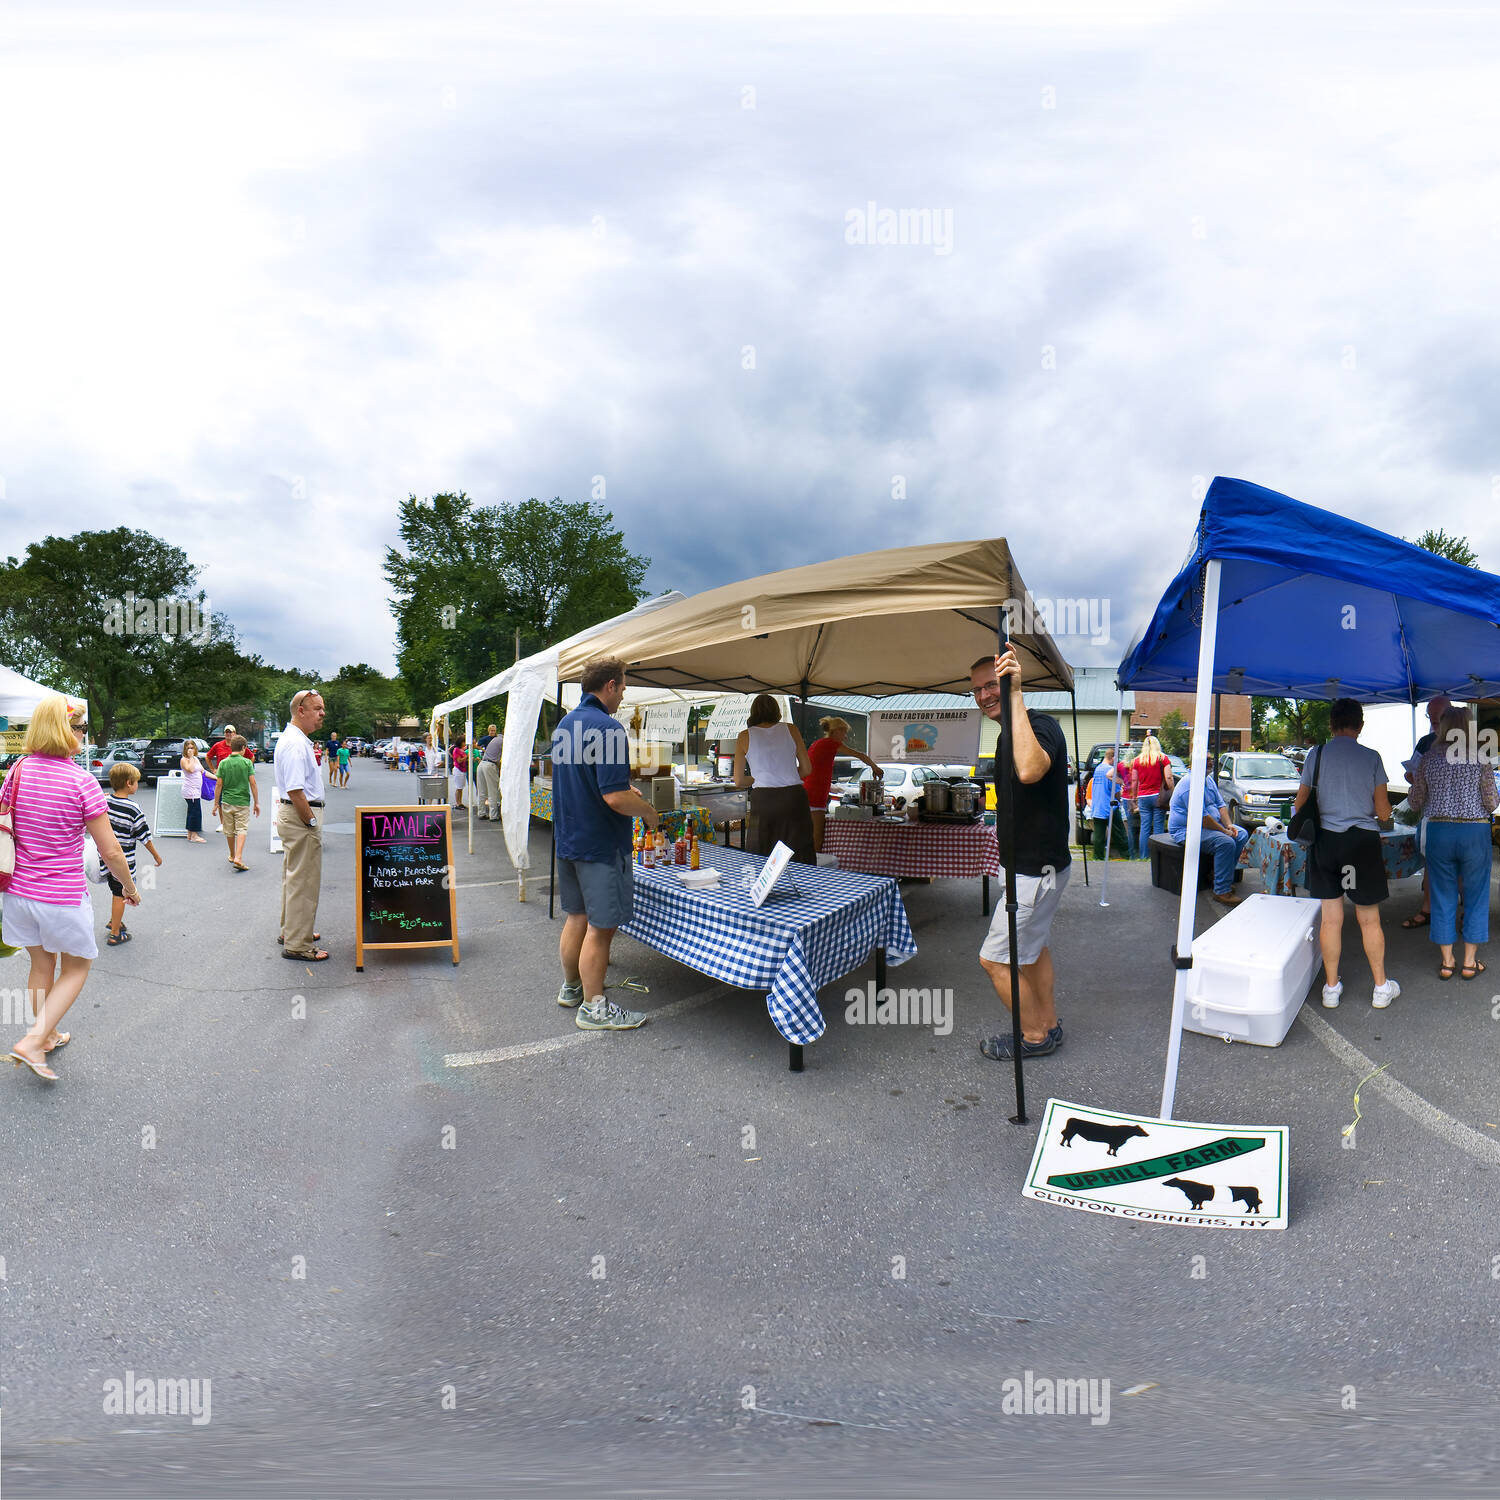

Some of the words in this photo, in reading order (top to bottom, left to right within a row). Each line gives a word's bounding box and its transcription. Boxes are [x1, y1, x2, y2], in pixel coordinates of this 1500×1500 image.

[880, 712, 902, 720] BLOCK
[904, 712, 935, 720] FACTORY
[936, 711, 968, 719] TAMALES
[363, 814, 443, 838] TAMALES
[368, 865, 398, 877] LAMB
[373, 877, 392, 888] RED
[1065, 1164, 1160, 1188] UPHILL
[1165, 1139, 1244, 1170] FARM
[1034, 1191, 1117, 1213] CLINTON
[1122, 1208, 1233, 1228] CORNERS,
[1240, 1219, 1271, 1228] NY
